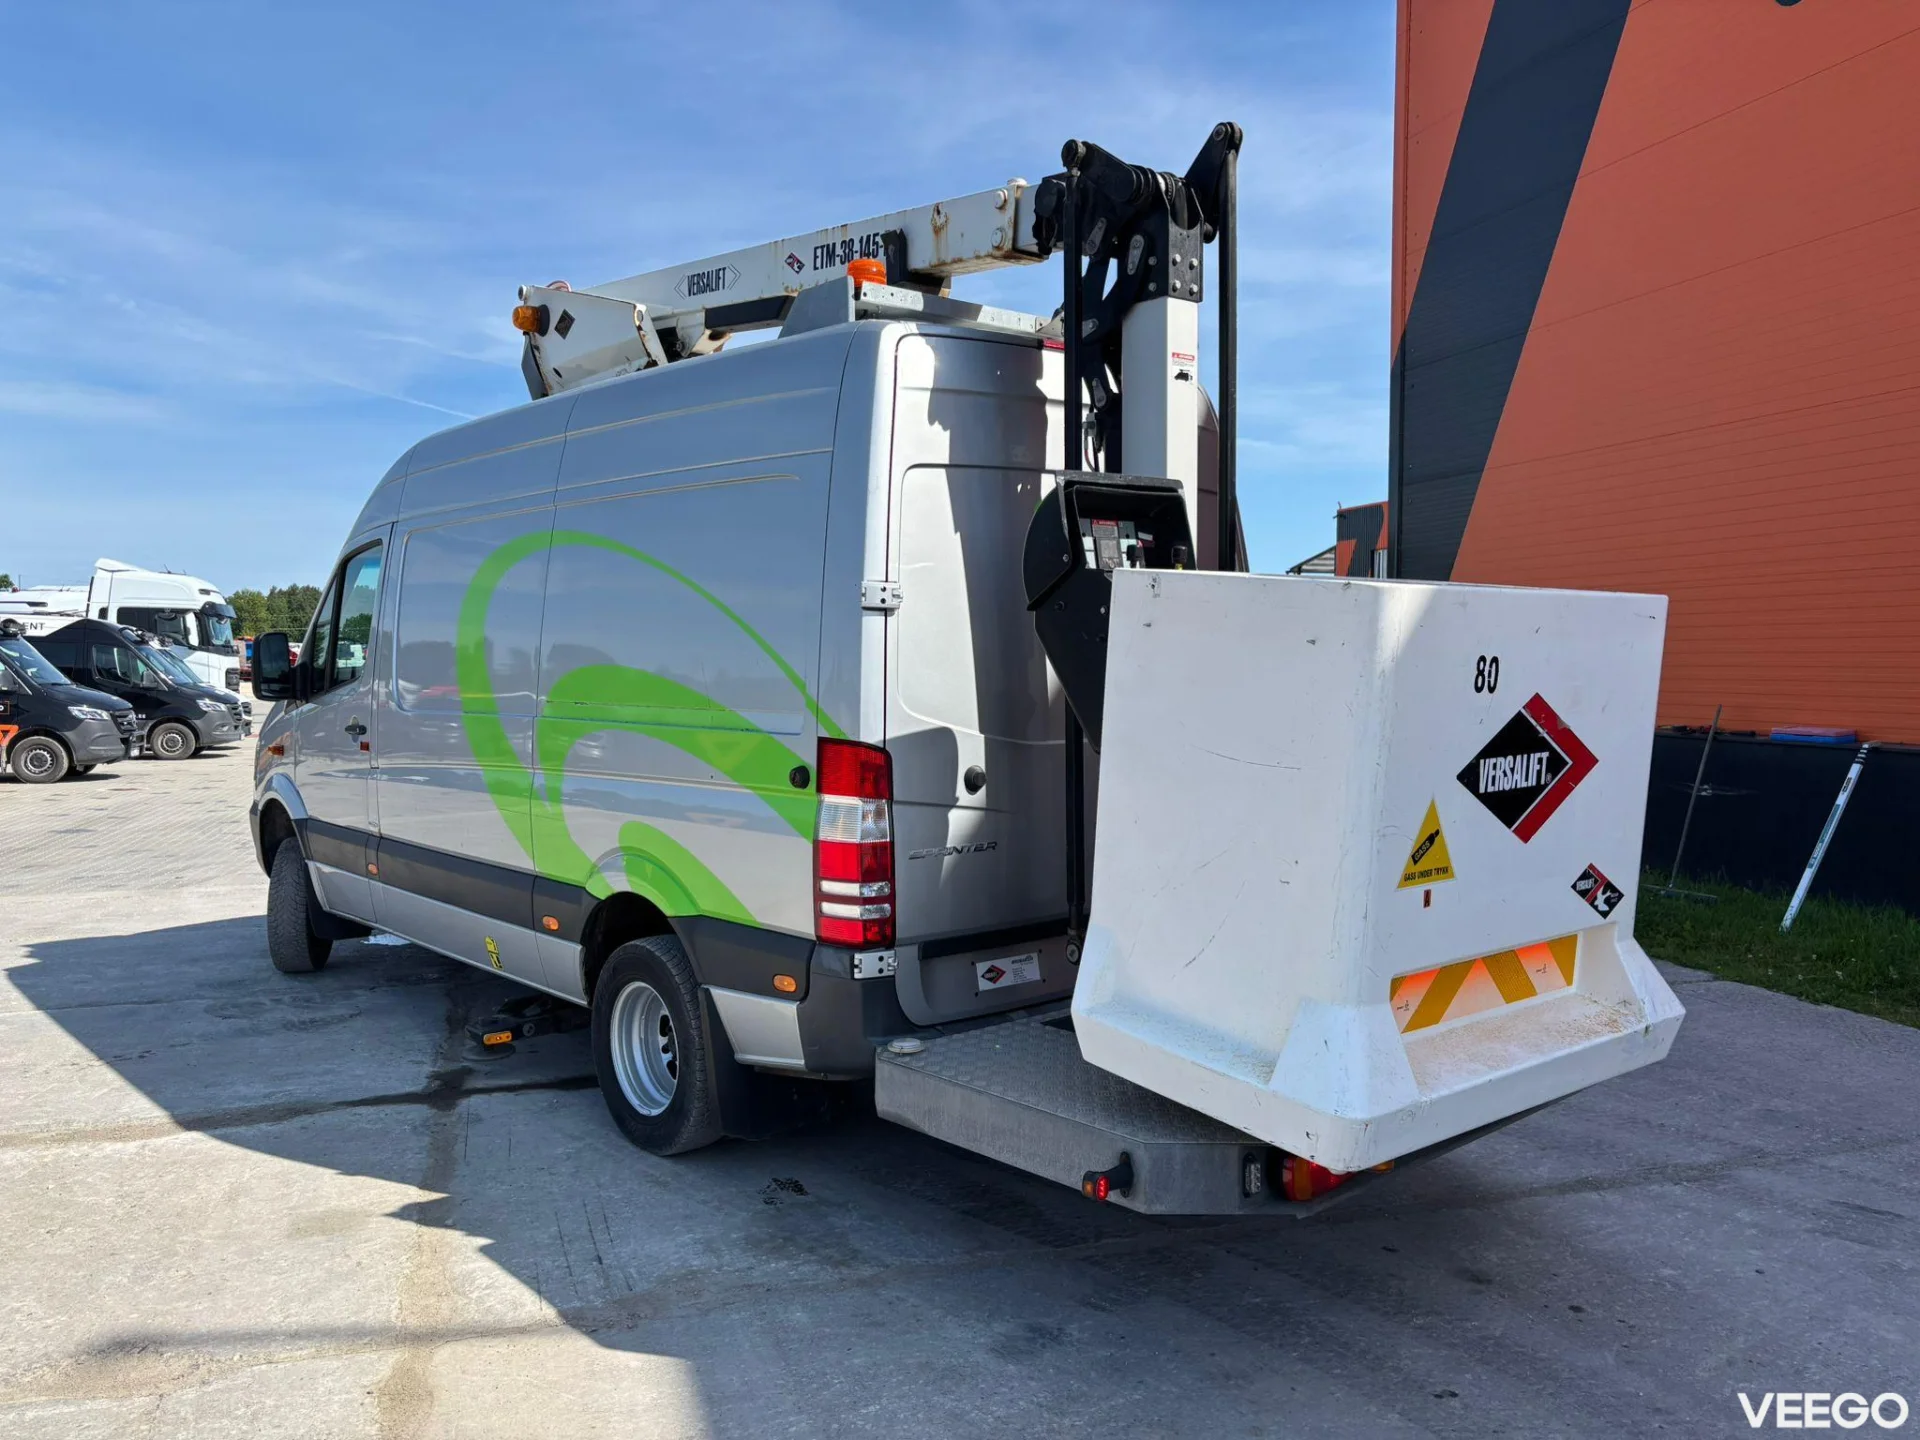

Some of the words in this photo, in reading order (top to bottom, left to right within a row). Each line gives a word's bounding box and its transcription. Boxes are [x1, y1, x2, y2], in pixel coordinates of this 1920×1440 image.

[813, 232, 886, 271] ETM-38-145-
[687, 266, 727, 297] VERSALIFT
[1474, 655, 1500, 694] 80
[1478, 751, 1551, 794] VERSALIFT
[908, 841, 998, 860] SPRINTER
[1413, 840, 1431, 861] GASS
[1403, 871, 1417, 882] GASS
[1417, 868, 1433, 879] UNDER
[1433, 866, 1449, 876] TRYKK
